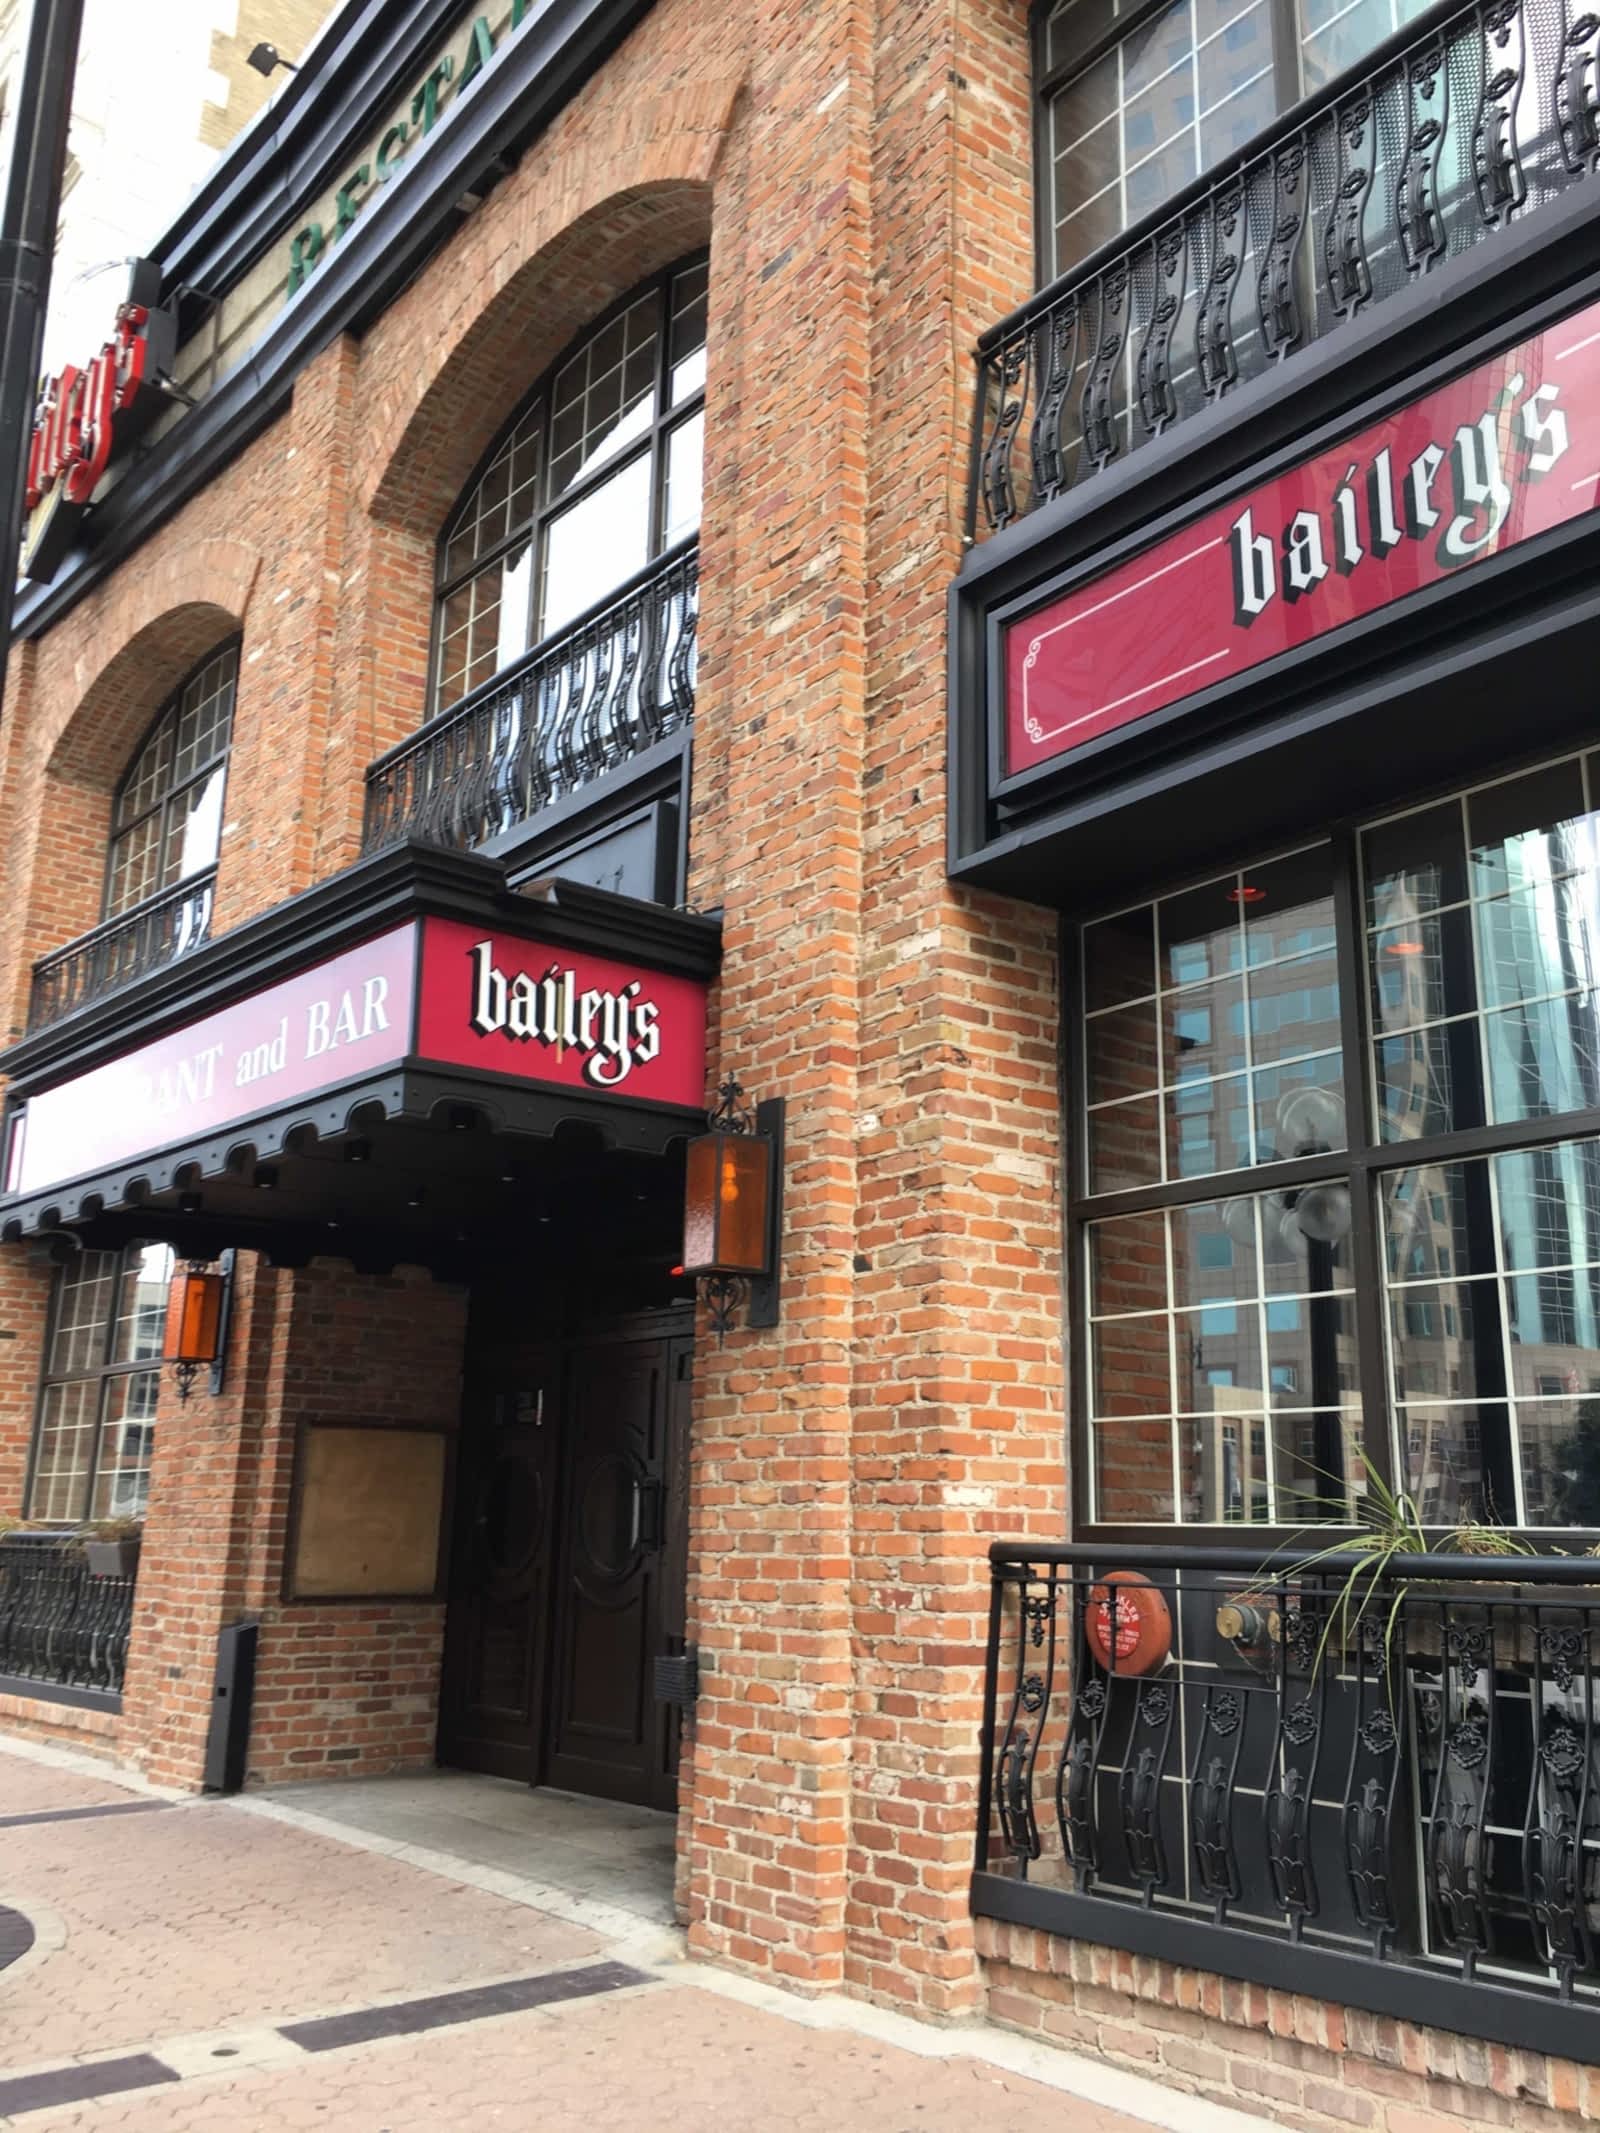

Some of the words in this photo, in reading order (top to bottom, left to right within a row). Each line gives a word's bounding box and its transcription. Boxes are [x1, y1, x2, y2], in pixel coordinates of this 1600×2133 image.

[287, 0, 526, 300] RESTA
[1229, 372, 1569, 627] bailey's
[235, 1017, 289, 1087] and
[304, 975, 390, 1060] BAR
[467, 939, 660, 1088] bailey's
